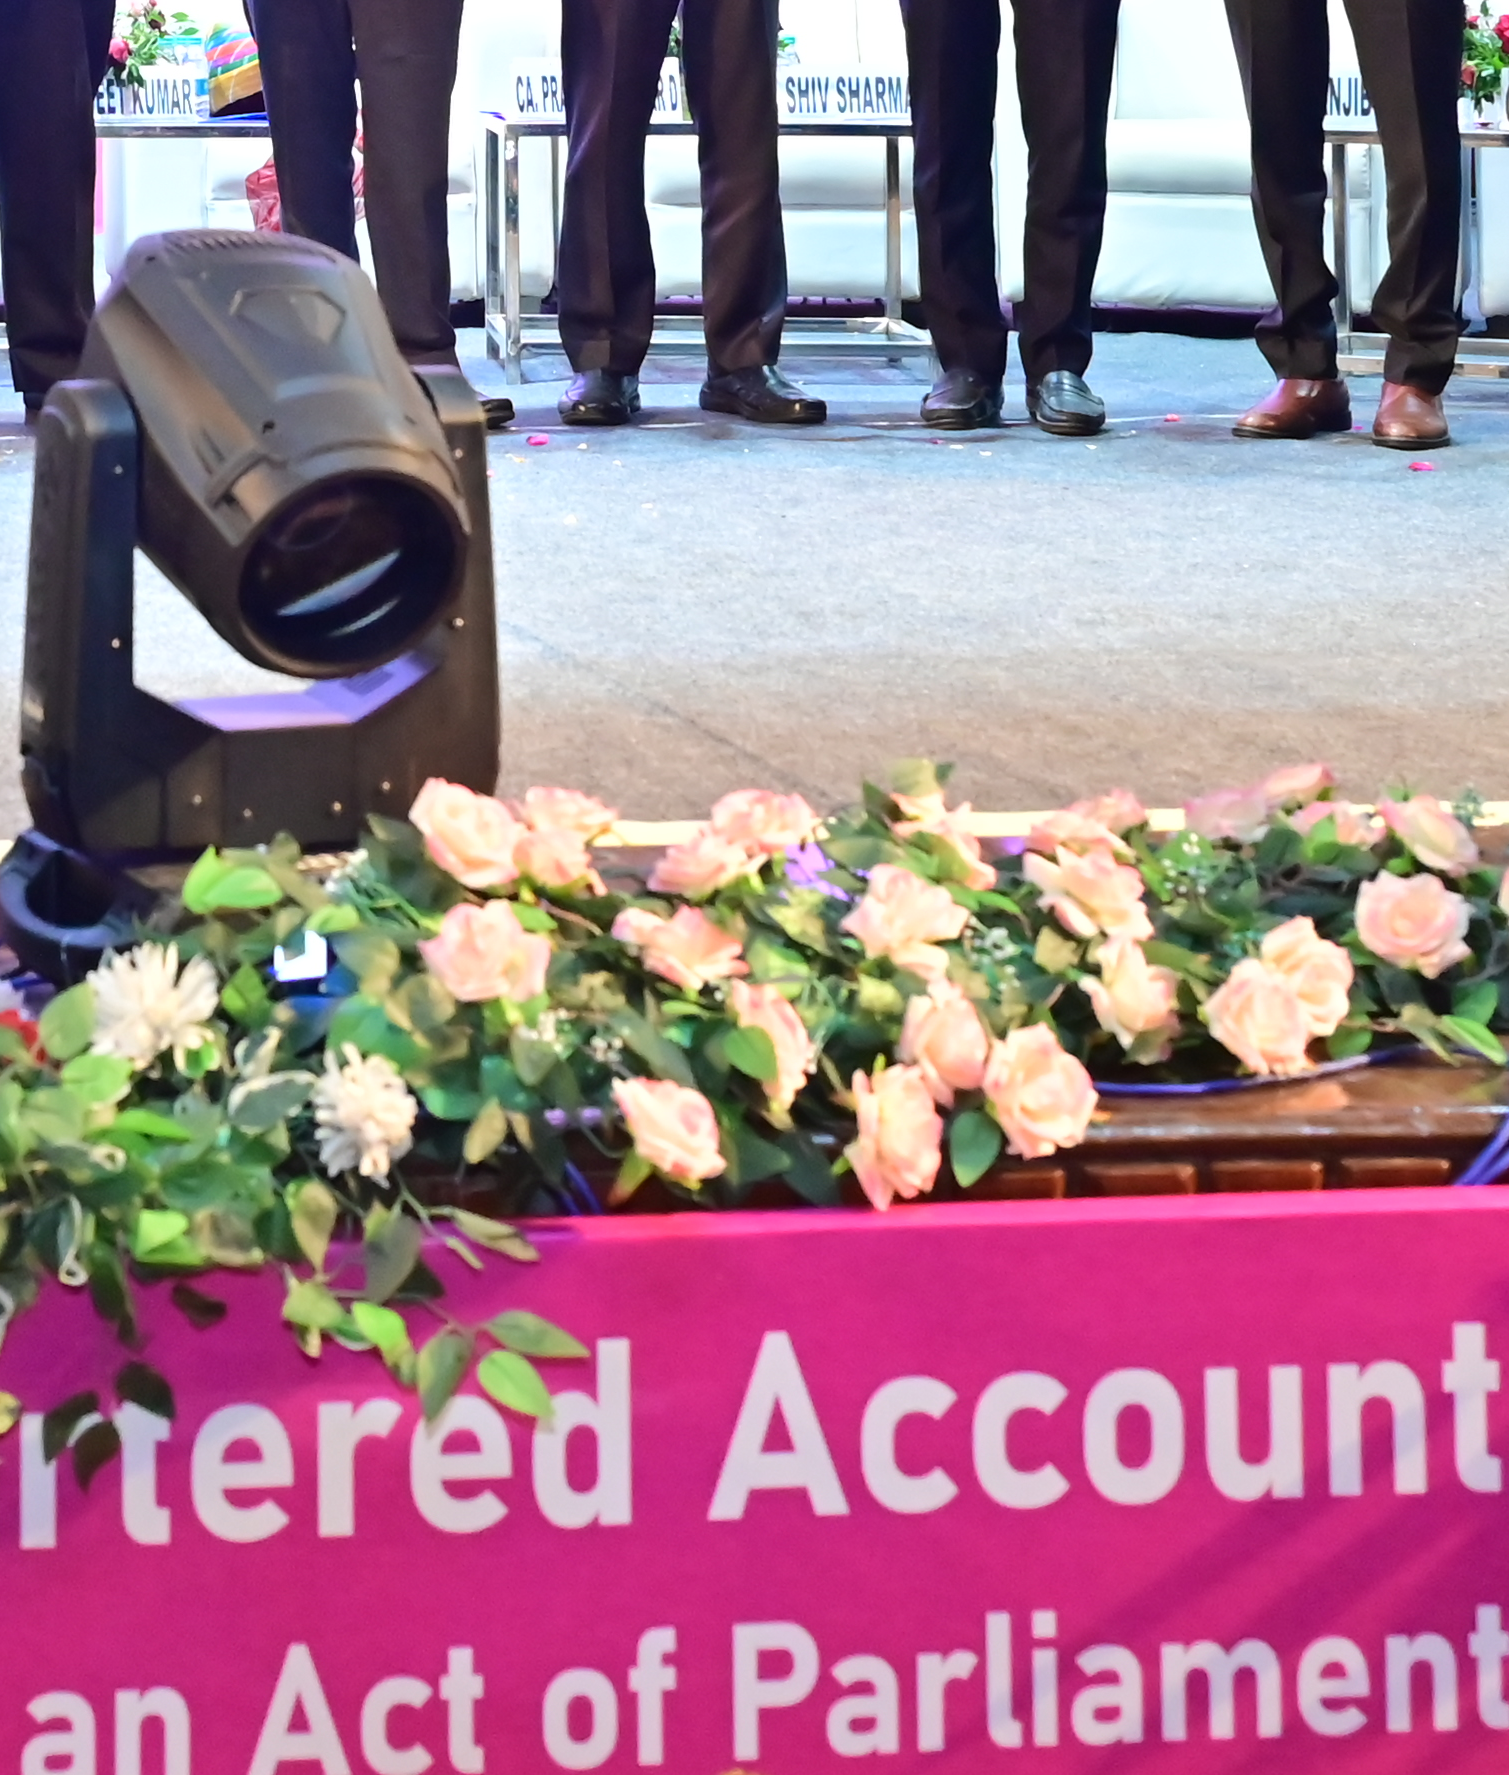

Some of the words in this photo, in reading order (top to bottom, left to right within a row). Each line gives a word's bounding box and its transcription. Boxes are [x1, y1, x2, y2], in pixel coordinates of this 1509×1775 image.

[132, 78, 193, 115] KUMAR
[516, 75, 539, 113] CA.
[785, 76, 829, 114] SHIV
[18, 1682, 188, 1775] an
[245, 1639, 484, 1775] Act
[539, 1626, 678, 1770] of
